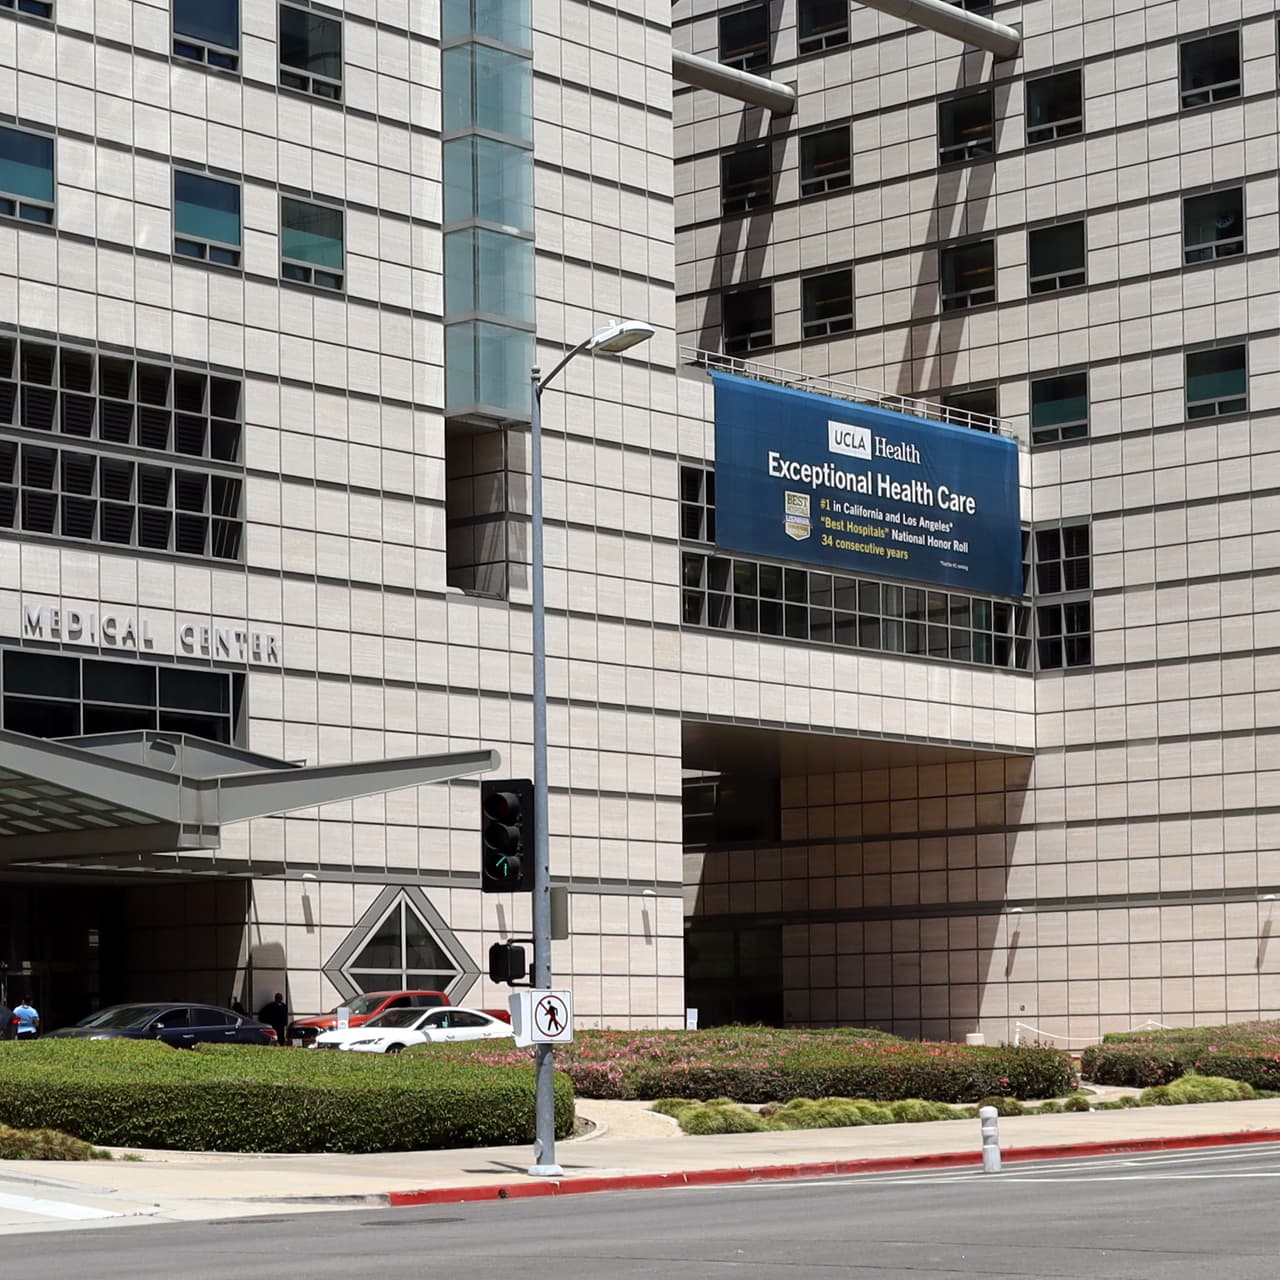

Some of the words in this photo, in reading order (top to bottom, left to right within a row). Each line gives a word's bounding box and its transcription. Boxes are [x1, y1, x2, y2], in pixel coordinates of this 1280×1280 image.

[834, 430, 866, 451] UCLA
[874, 436, 921, 464] Health
[768, 450, 873, 495] Exceptional
[877, 472, 934, 507] Health
[937, 485, 976, 515] Care
[786, 493, 809, 508] BEST
[820, 498, 831, 511] #1
[832, 500, 842, 513] in
[843, 502, 884, 521] California
[884, 512, 901, 524] and
[902, 513, 917, 527] Los
[821, 534, 833, 547] 34
[835, 539, 885, 556] consecutive
[886, 548, 909, 560] years
[891, 529, 926, 545] National
[927, 535, 952, 551] Honor
[953, 540, 969, 553] Roll
[23, 605, 154, 644] MEDICAL
[180, 623, 280, 659] CENTER
